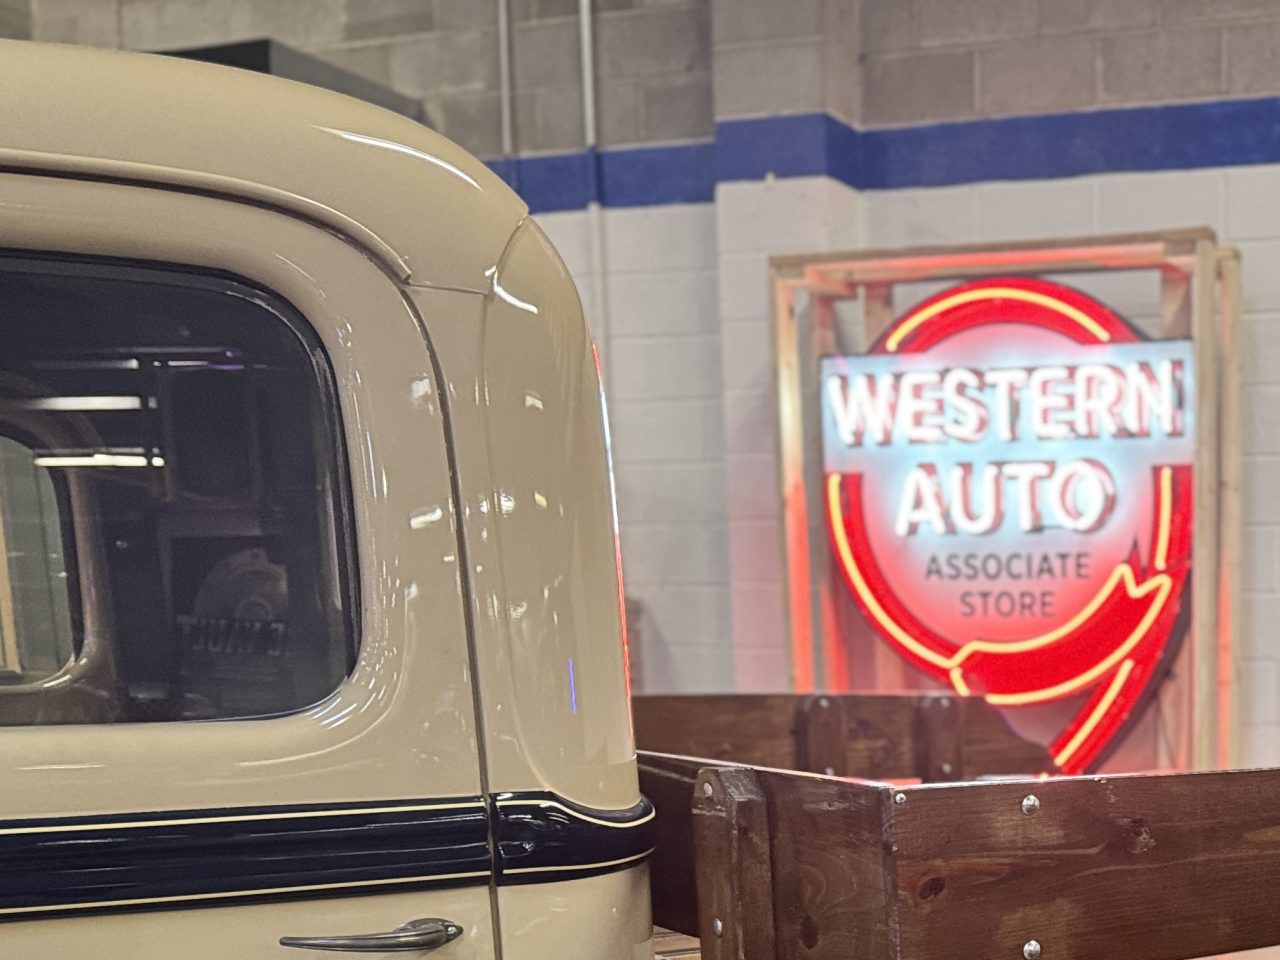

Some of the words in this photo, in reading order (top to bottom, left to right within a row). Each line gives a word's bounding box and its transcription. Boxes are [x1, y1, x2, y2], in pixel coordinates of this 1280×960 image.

[827, 359, 1184, 447] WESTERN
[894, 458, 1116, 537] AUTO
[924, 552, 1091, 581] ASSOCIATE
[959, 591, 1056, 618] STORE
